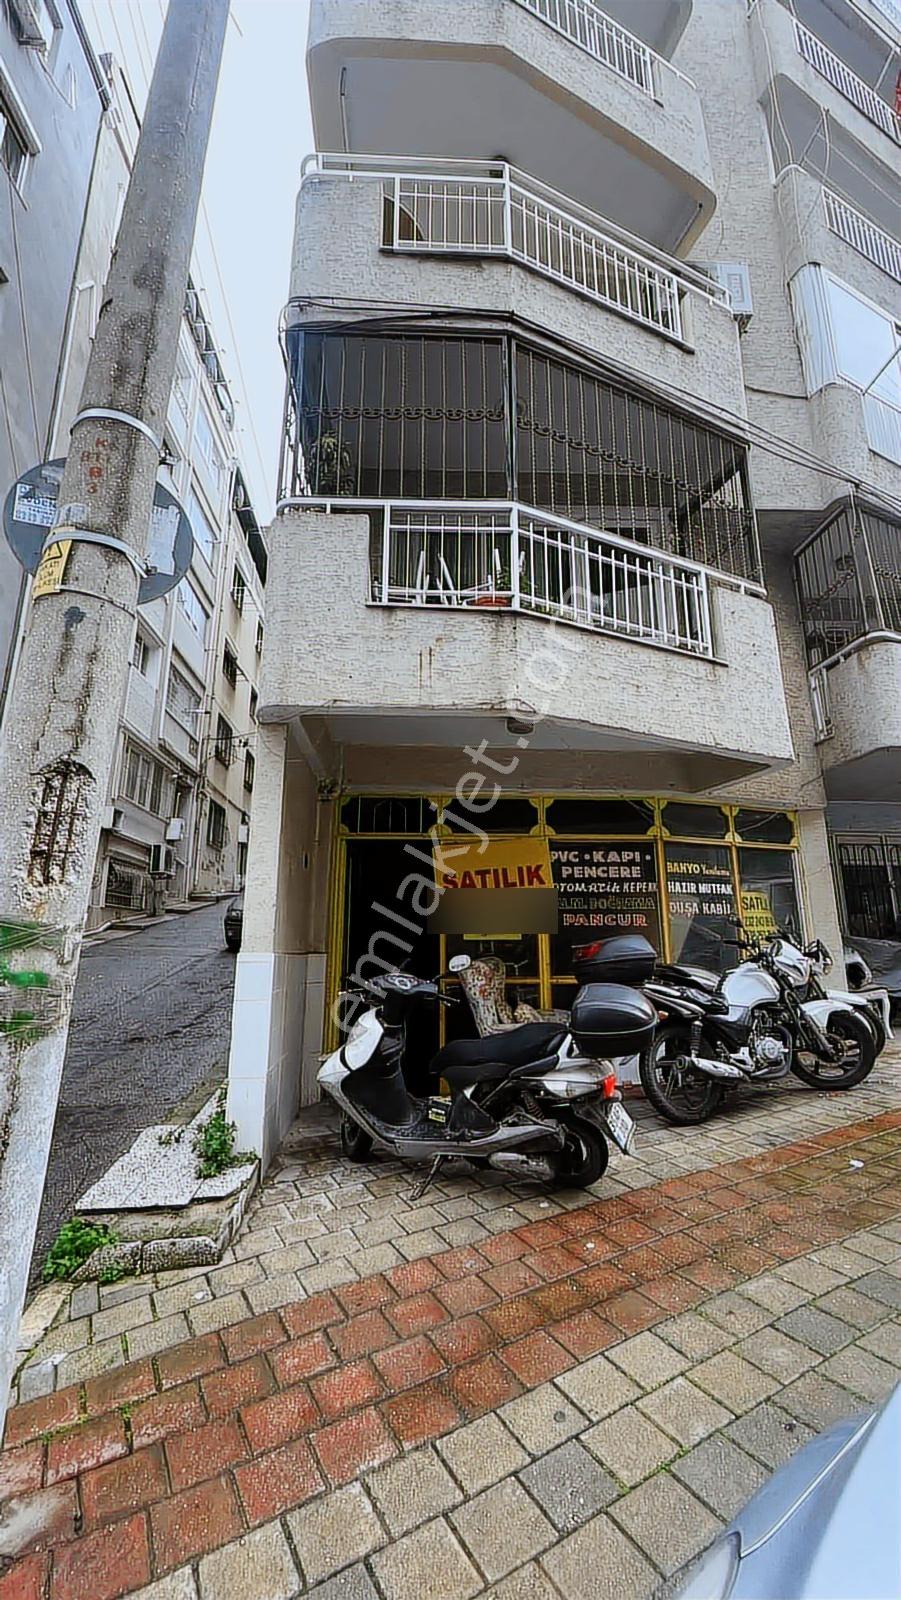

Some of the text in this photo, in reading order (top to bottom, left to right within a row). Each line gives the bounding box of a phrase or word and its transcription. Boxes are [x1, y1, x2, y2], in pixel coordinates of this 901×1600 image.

[551, 851, 641, 863] PVC KAPI
[561, 866, 642, 878] PENCERE
[666, 862, 700, 875] BANYO
[442, 864, 546, 888] SATILIK
[667, 881, 733, 896] HAZIR MUTFAK
